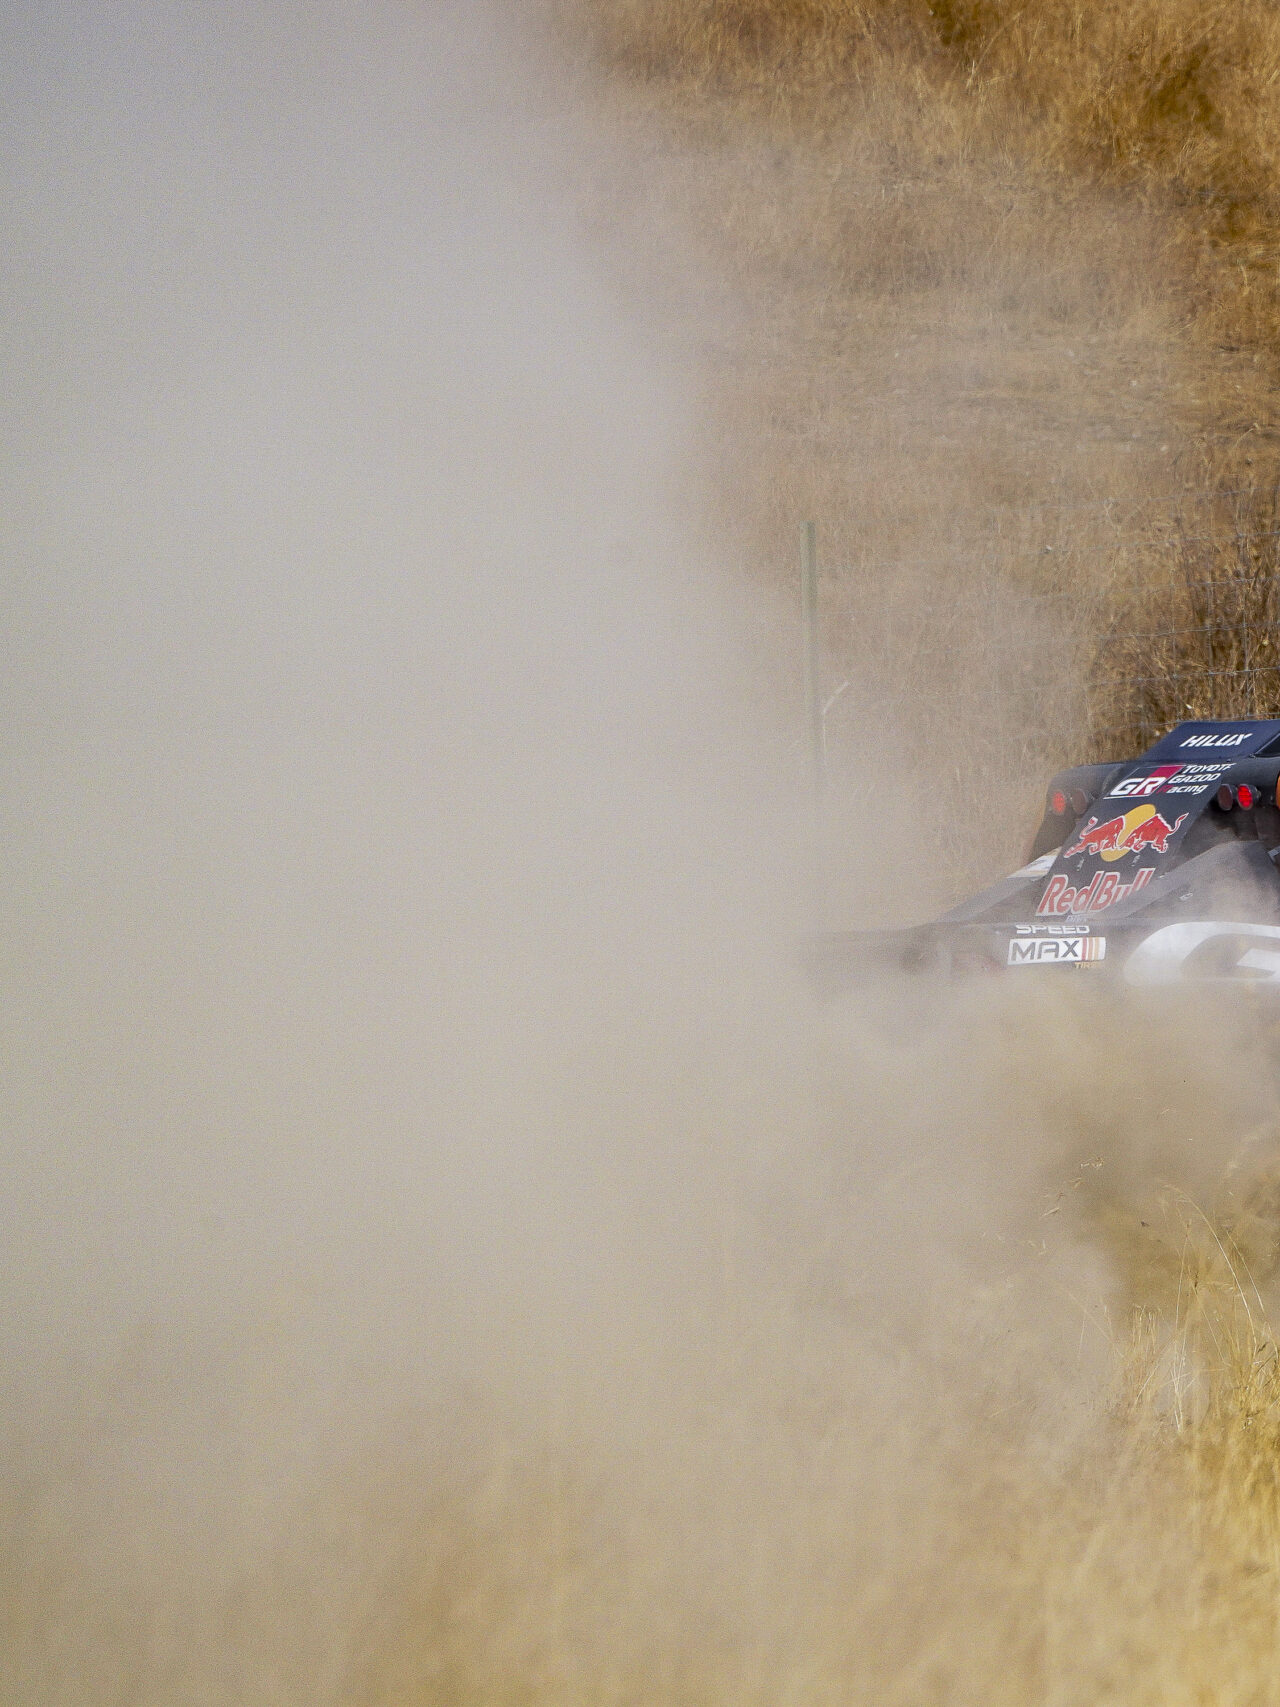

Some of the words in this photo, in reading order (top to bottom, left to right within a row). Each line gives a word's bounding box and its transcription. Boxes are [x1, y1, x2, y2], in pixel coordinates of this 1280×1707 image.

[1179, 733, 1253, 747] HILUX
[1167, 773, 1221, 784] GAZOO
[1109, 777, 1167, 796] GR
[1156, 784, 1209, 796] Racing
[1015, 924, 1090, 934] SPEED
[1011, 939, 1080, 962] MAX
